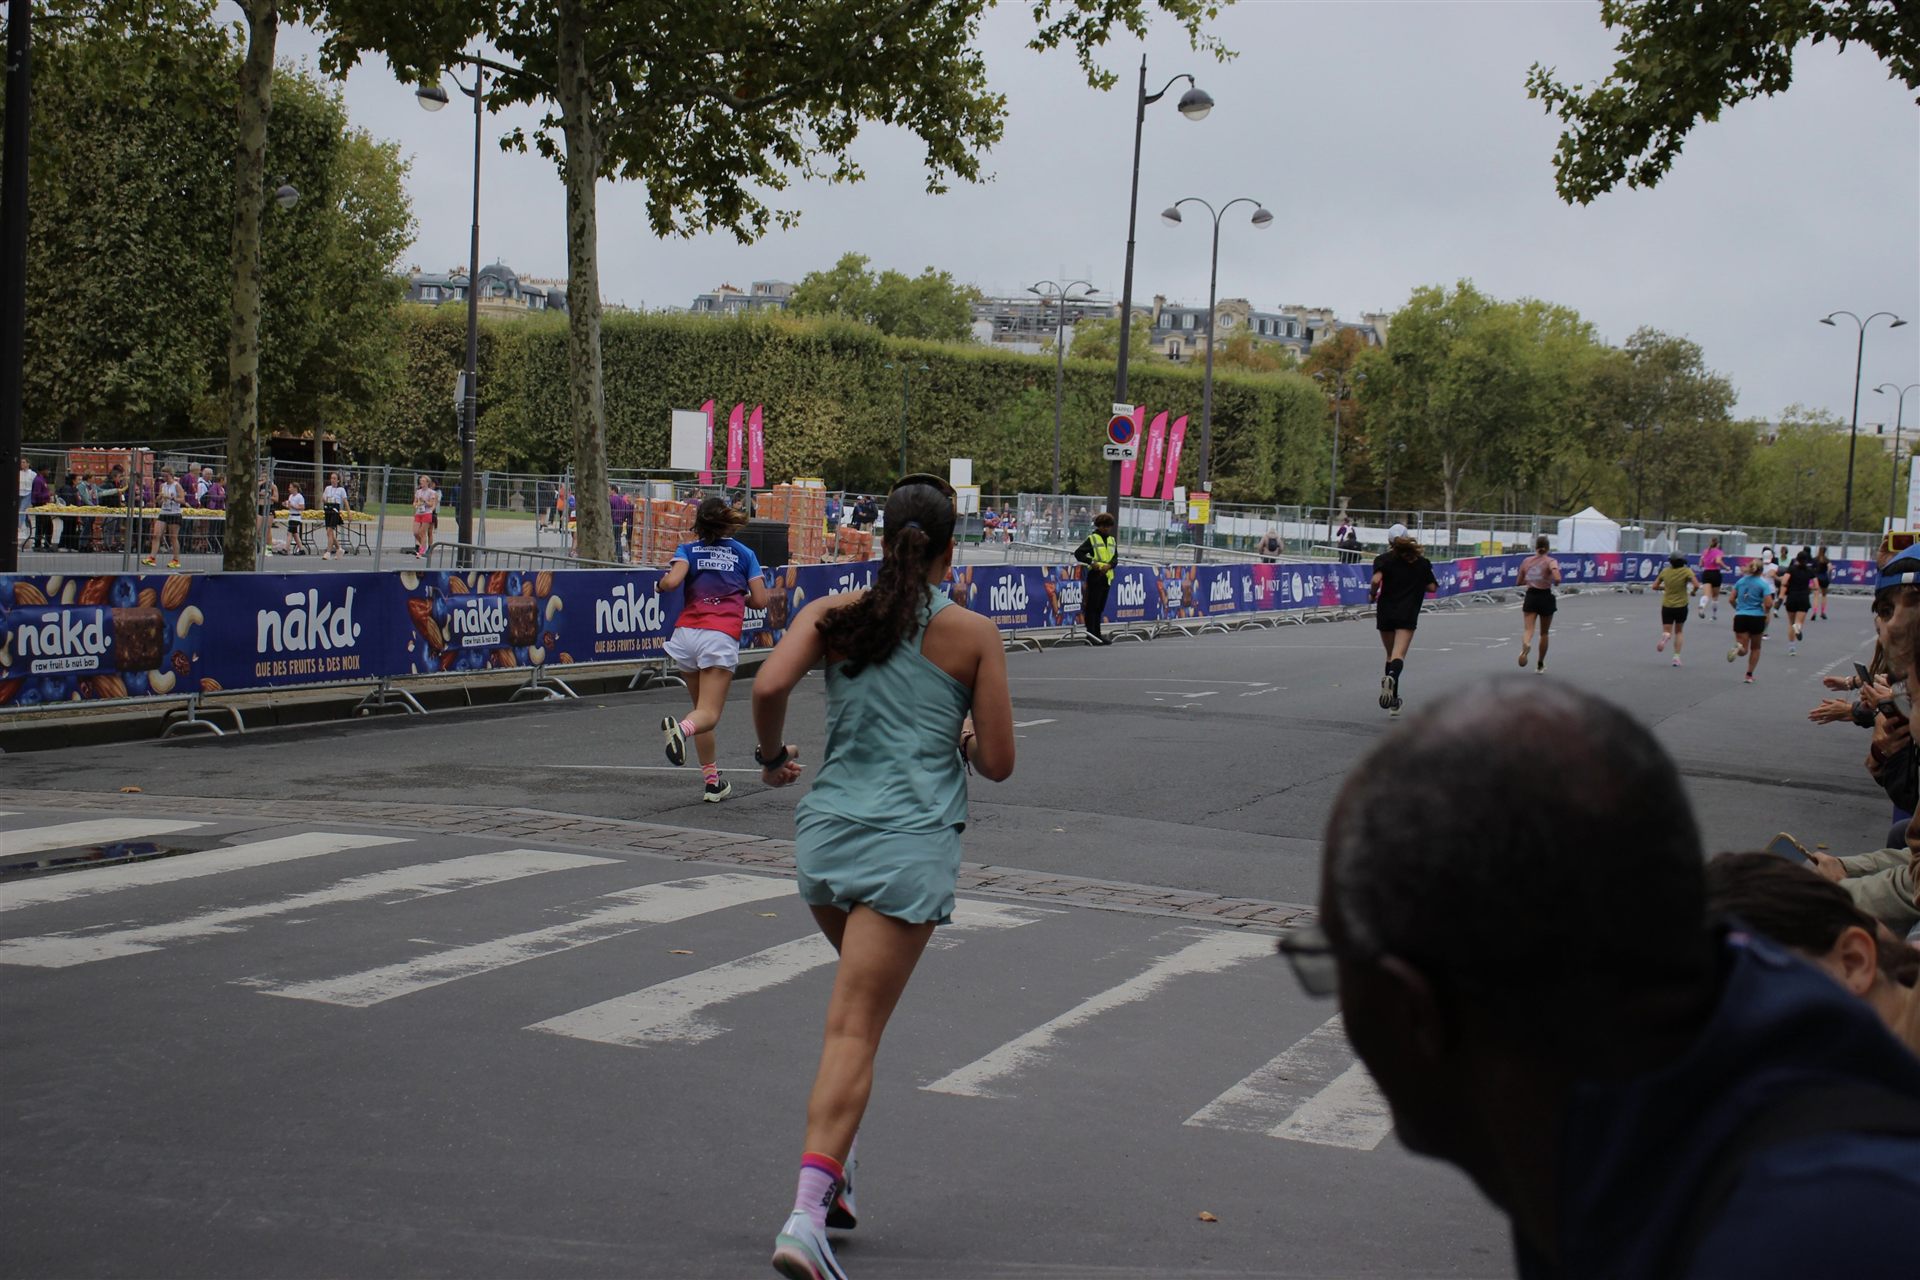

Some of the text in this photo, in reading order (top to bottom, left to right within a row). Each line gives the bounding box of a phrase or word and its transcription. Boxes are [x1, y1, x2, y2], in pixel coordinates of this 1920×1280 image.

[699, 560, 733, 571] Energy
[595, 641, 606, 653] QUE
[606, 640, 616, 652] DES
[617, 639, 635, 652] FRUITS
[636, 638, 641, 651] &
[641, 638, 651, 650] DES
[35, 657, 95, 671] raw fruit & nut bar
[255, 655, 360, 677] QUE DES FRUITS & DES NOIX
